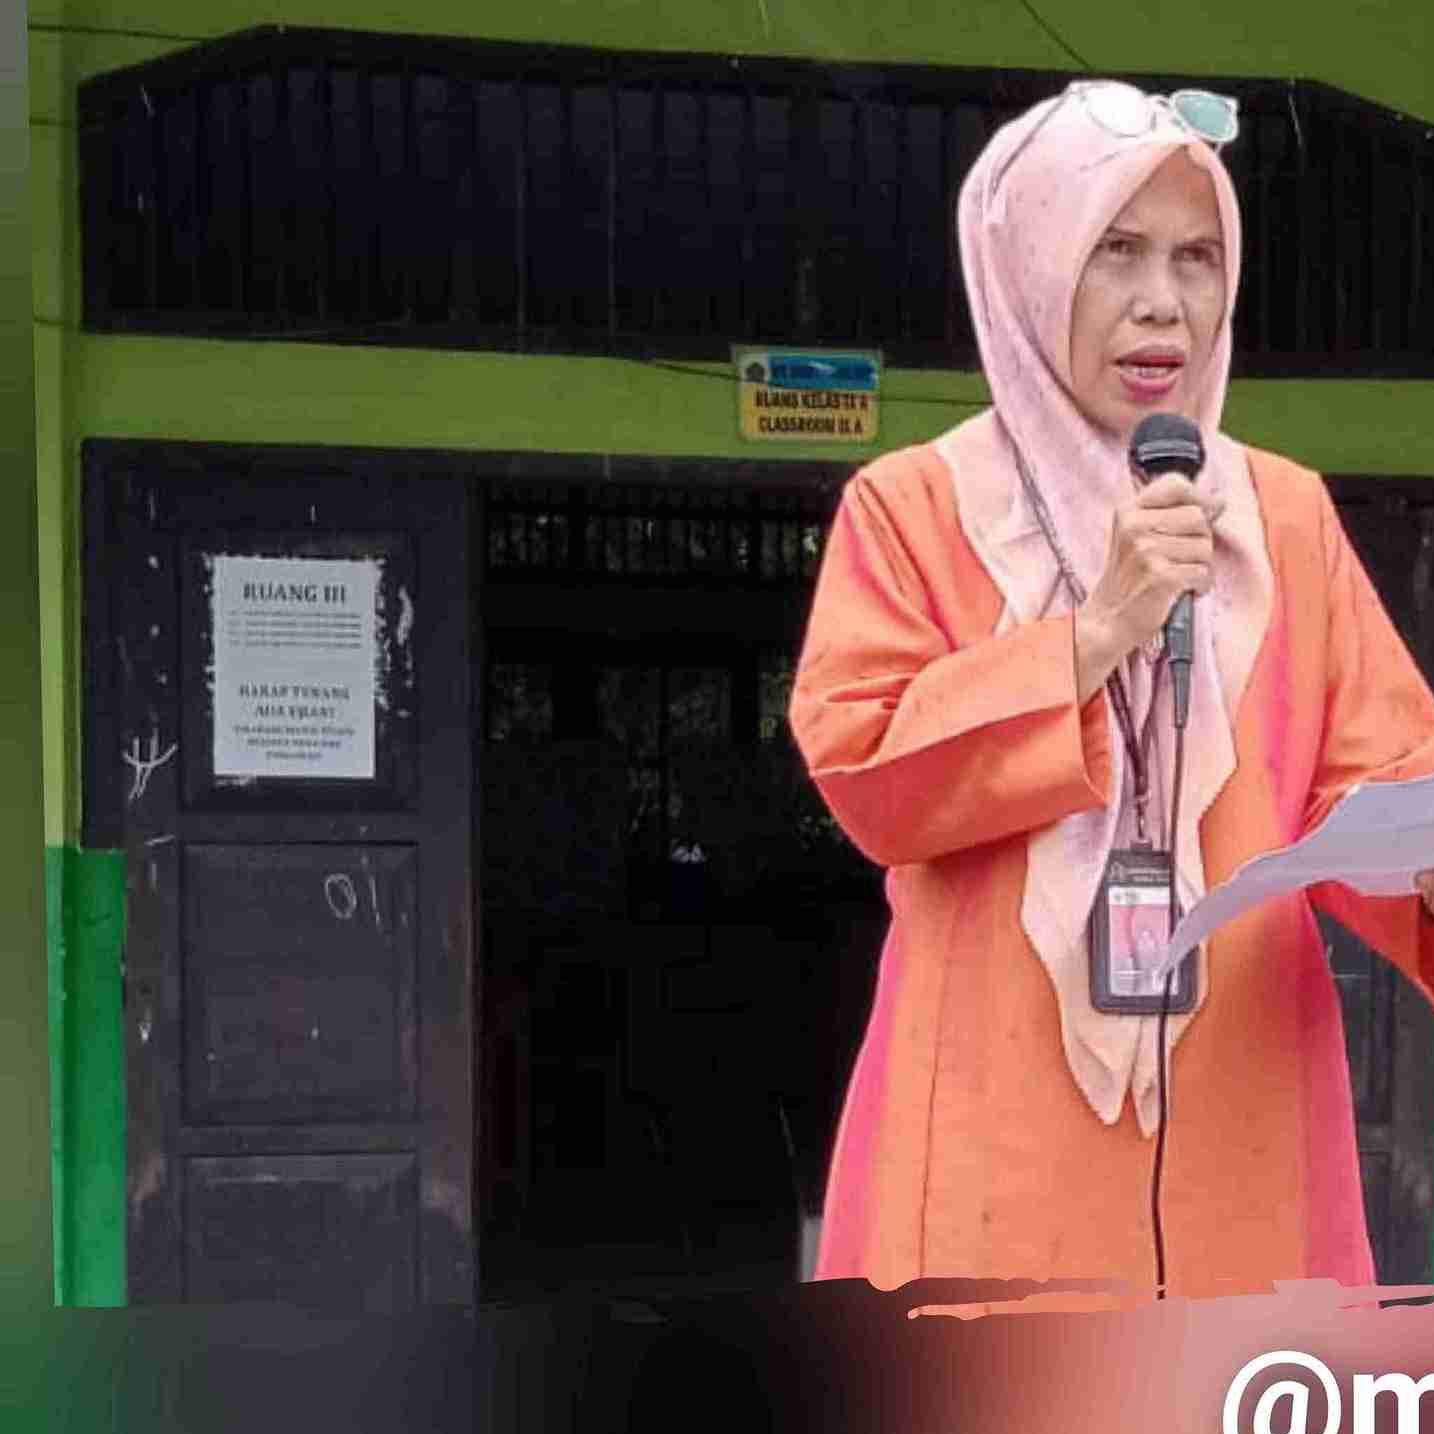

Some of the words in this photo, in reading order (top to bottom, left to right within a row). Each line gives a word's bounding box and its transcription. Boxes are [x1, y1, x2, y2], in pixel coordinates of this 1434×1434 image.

[759, 416, 835, 433] CLASSROOM
[243, 583, 318, 603] RUANG
[324, 584, 346, 605] III
[240, 684, 288, 699] HARAP
